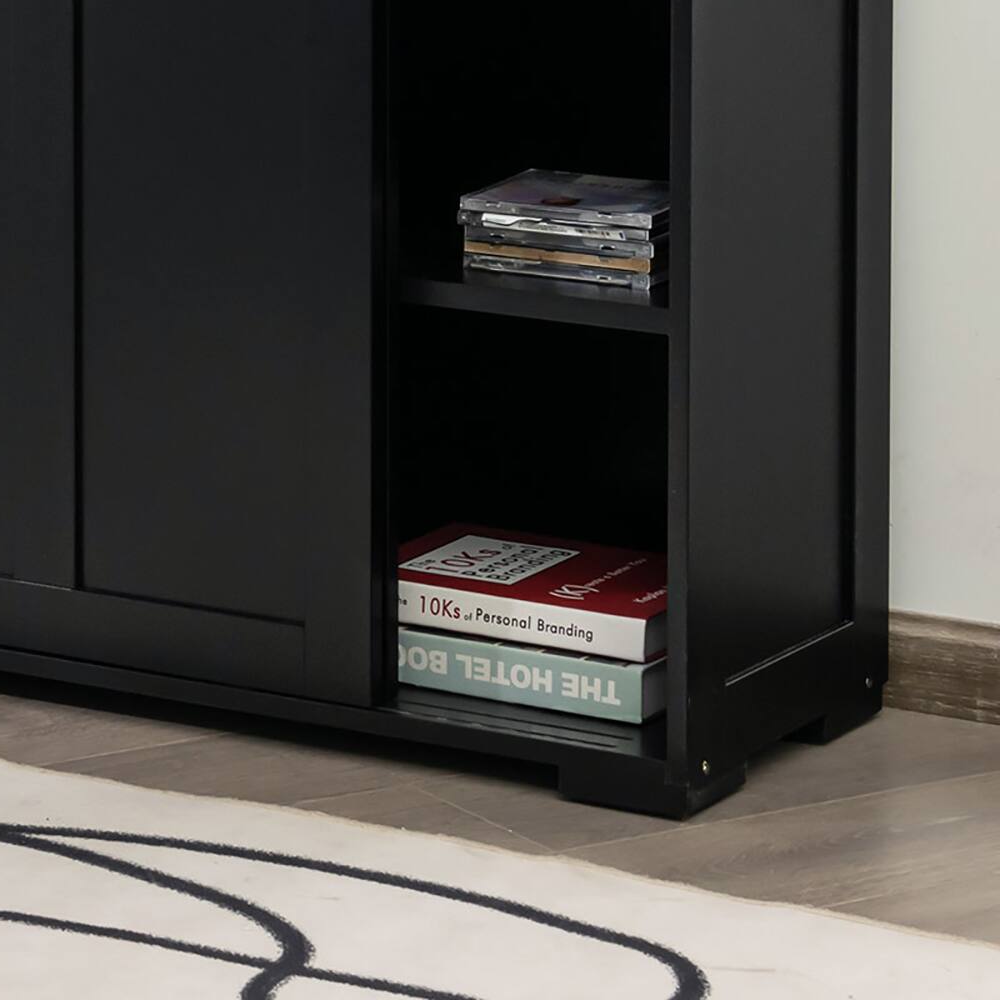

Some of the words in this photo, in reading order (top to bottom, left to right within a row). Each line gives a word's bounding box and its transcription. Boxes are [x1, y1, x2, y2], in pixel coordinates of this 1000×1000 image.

[419, 595, 461, 620] 10Ks
[464, 613, 473, 621] of
[475, 608, 532, 630] Personal
[537, 619, 594, 643] Branding
[455, 653, 553, 693] HOTEL
[561, 672, 622, 706] THE
